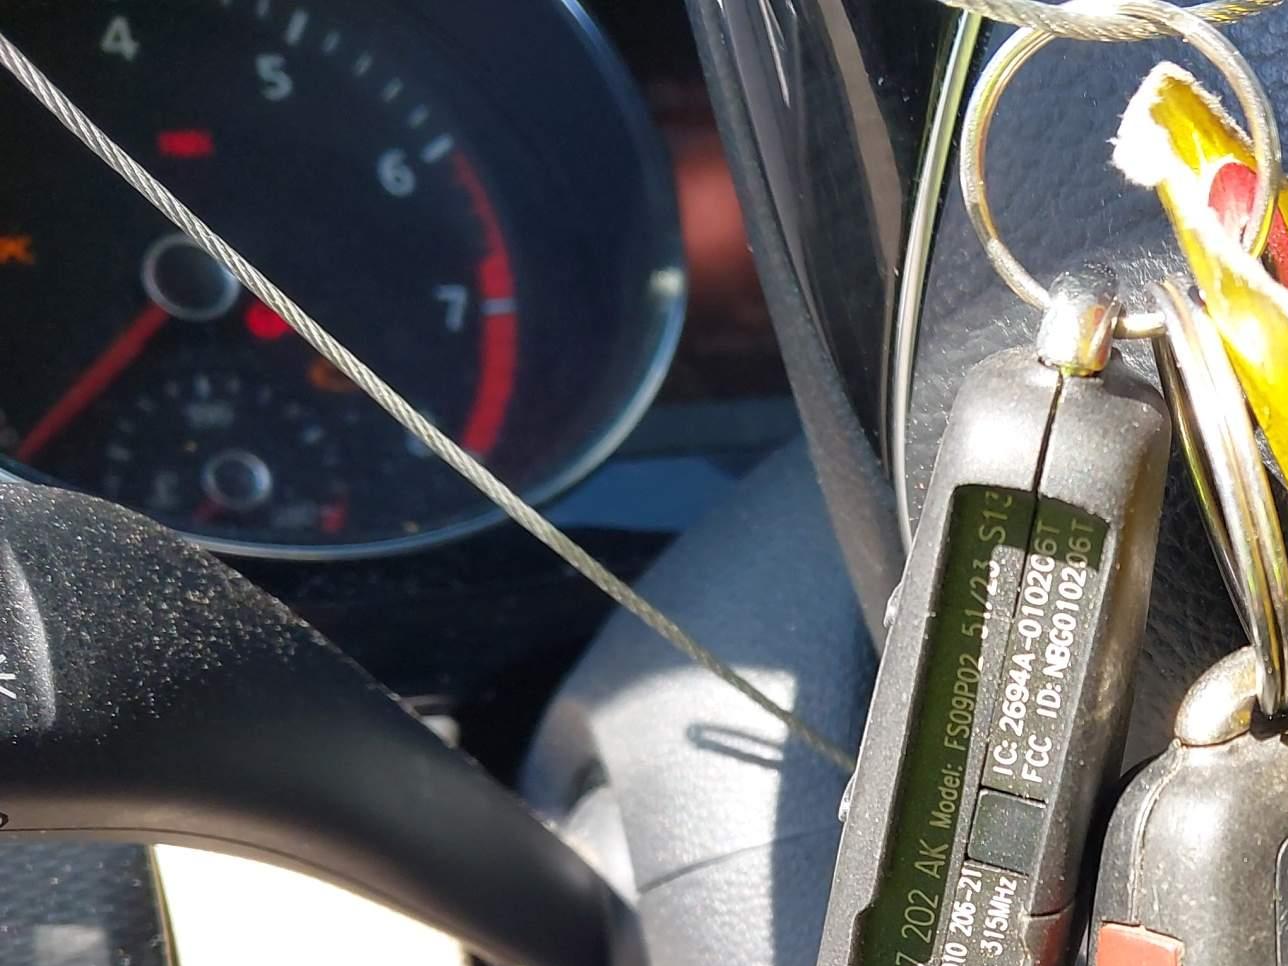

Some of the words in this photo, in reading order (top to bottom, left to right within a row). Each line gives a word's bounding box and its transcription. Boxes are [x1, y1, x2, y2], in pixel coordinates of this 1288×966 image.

[101, 15, 140, 62] 4
[254, 53, 294, 102] 5
[377, 149, 417, 198] 6
[432, 283, 469, 333] 7
[944, 653, 985, 751] FS09P02
[1020, 734, 1053, 784] FCC
[929, 764, 964, 830] Model:
[914, 839, 950, 880] AK
[901, 889, 940, 945] 202
[950, 866, 984, 938] 206-21
[980, 875, 1018, 957] 315MHz
